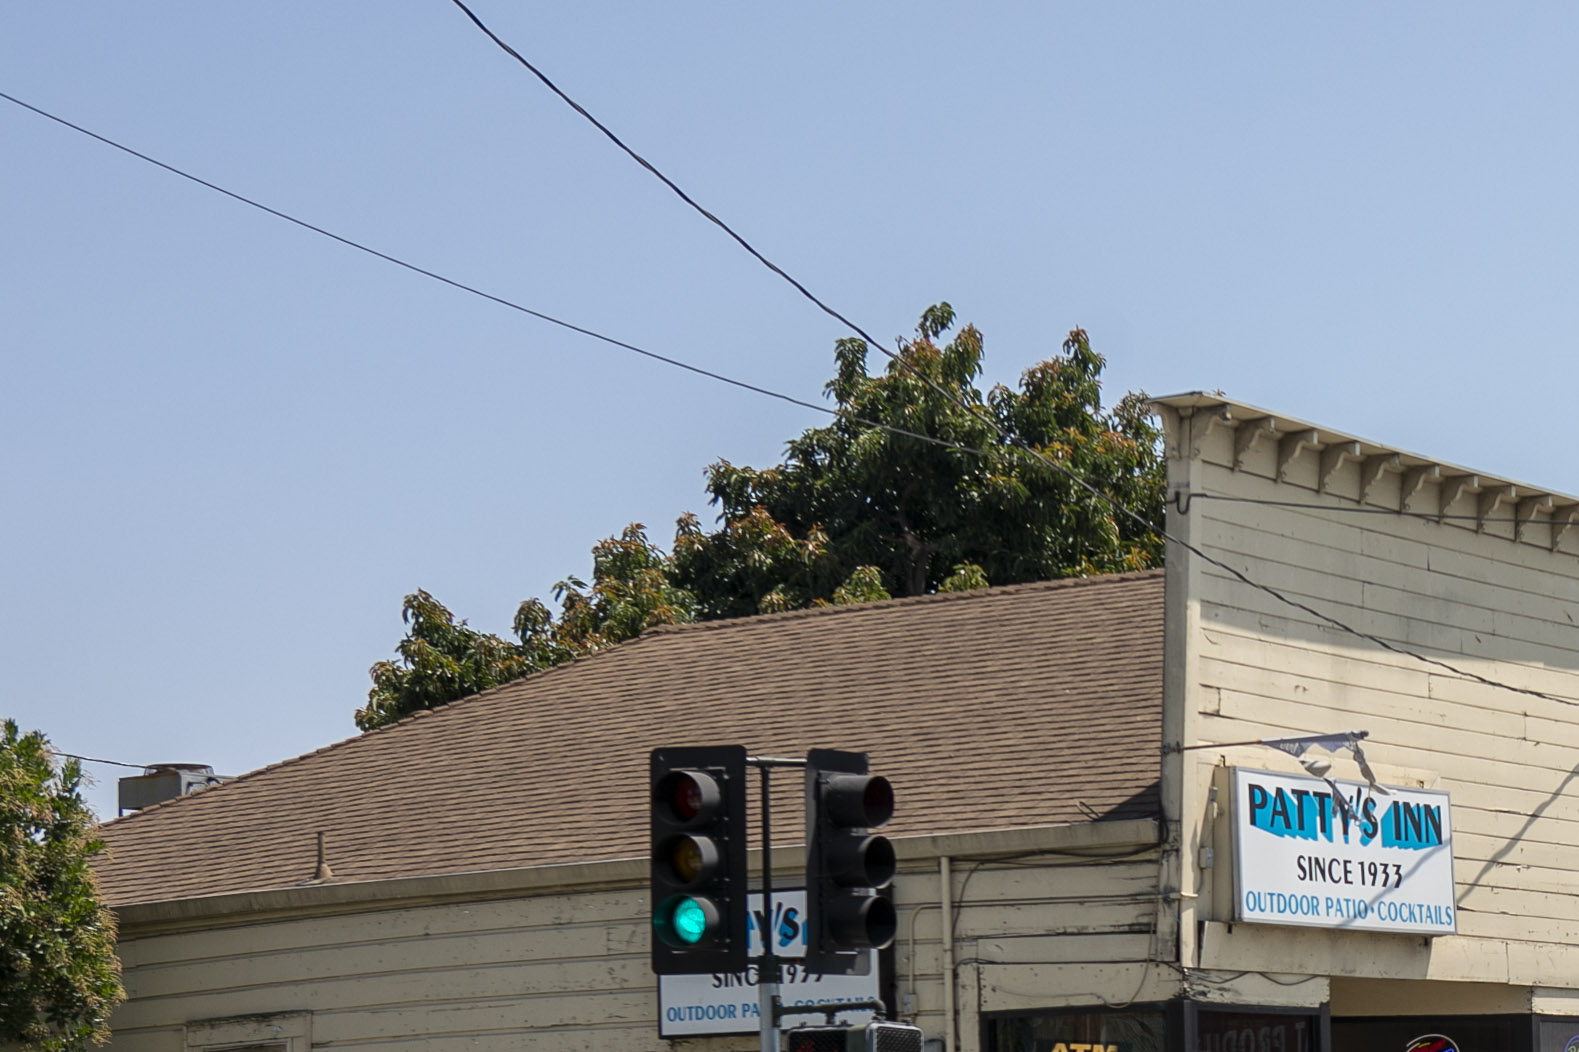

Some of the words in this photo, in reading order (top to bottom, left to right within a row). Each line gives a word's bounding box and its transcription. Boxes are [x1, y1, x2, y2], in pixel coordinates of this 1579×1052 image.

[1248, 784, 1379, 845] PATTY'S
[1388, 800, 1443, 848] INN
[1297, 854, 1354, 885] SINCE
[1359, 861, 1403, 889] 1933
[1245, 890, 1320, 916] OUTDOOR
[712, 966, 759, 988] SINC
[667, 1004, 736, 1022] OUTDOOR
